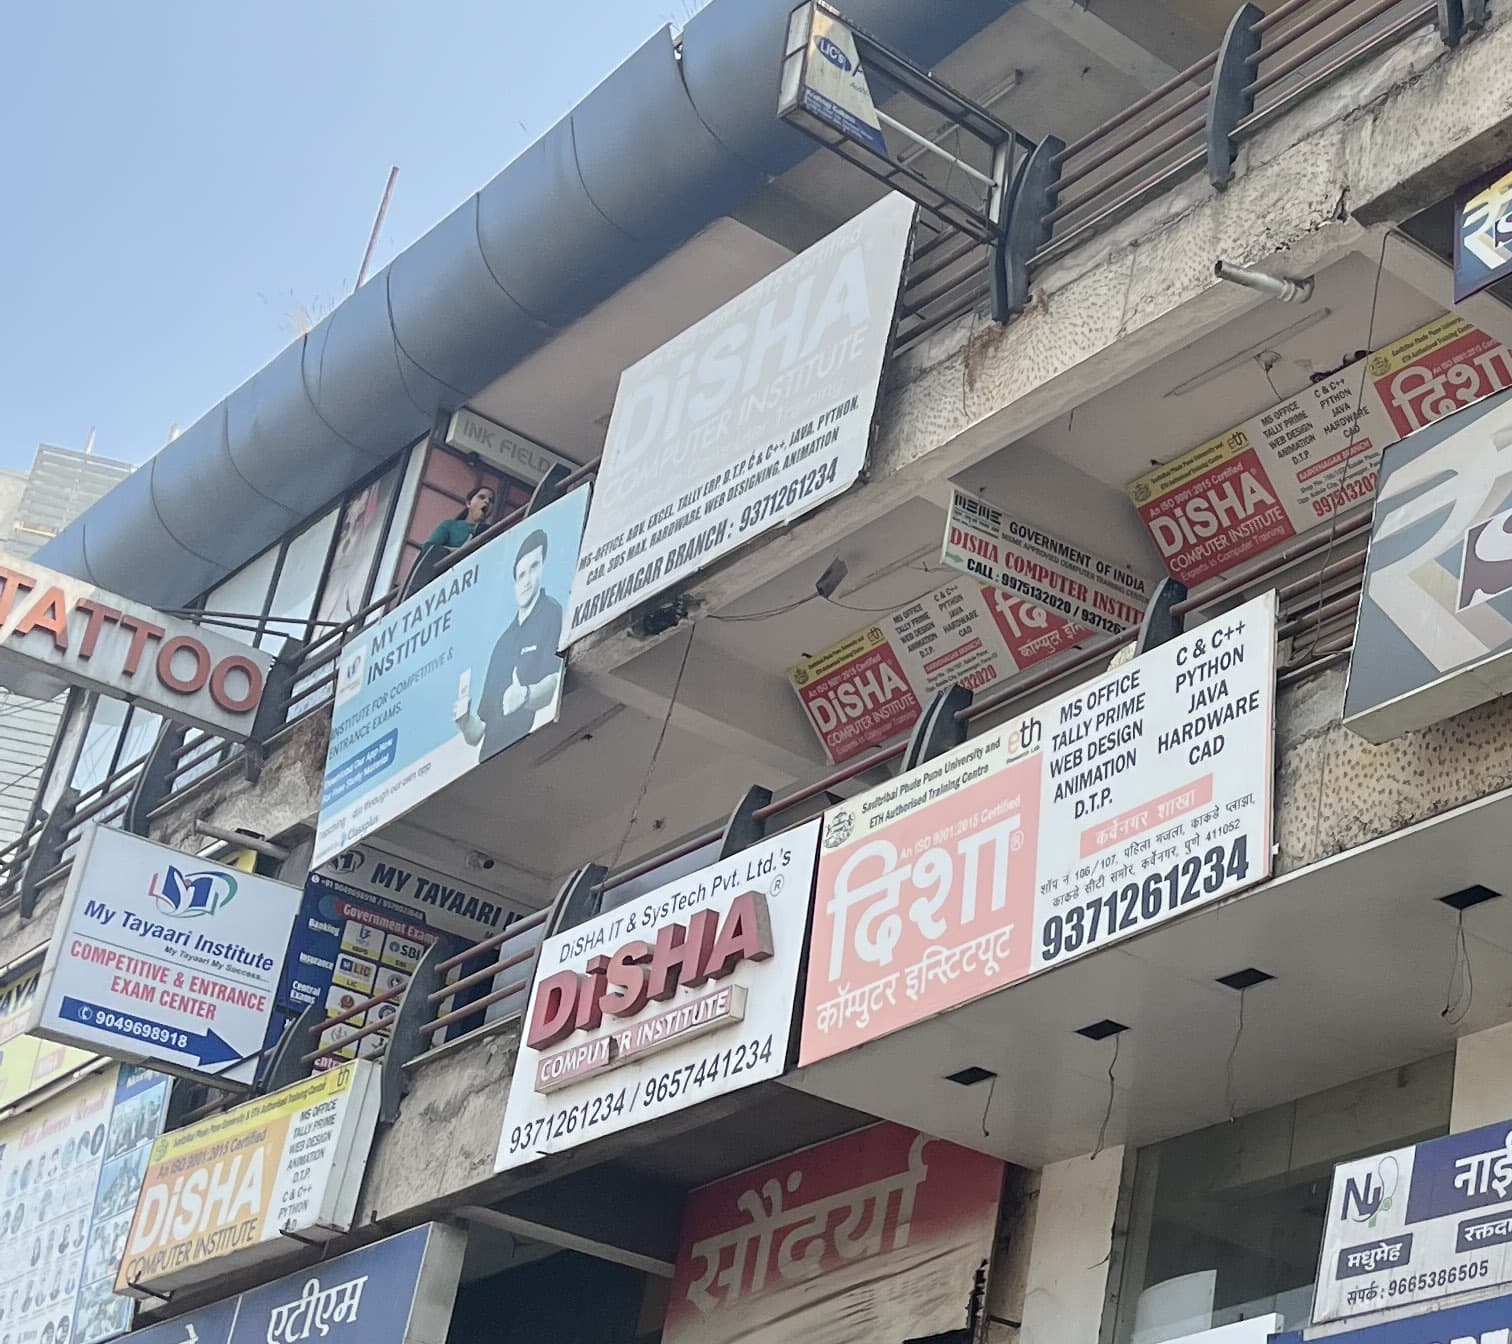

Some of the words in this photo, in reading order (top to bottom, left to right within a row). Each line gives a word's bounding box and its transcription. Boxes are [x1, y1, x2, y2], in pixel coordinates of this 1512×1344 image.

[617, 245, 871, 470] DiSHA
[1320, 389, 1352, 409] PYTHON
[1332, 403, 1351, 417] JAVA
[463, 420, 496, 449] INK
[571, 557, 662, 630] KARVENAGAR
[739, 456, 840, 532] 9371261234
[1149, 471, 1275, 557] DiSHA
[1169, 534, 1228, 572] COMPUTER
[1228, 506, 1284, 543] INSTITUTE
[950, 526, 999, 565] DISHA
[1005, 551, 1088, 603] COMPUTER
[967, 558, 994, 581] CALL
[1002, 573, 1071, 614] 9975132020
[1010, 522, 1091, 569] GOVERNMENT
[1096, 559, 1110, 576] OF
[1114, 570, 1145, 593] INDIA
[370, 625, 396, 657] MY
[401, 564, 479, 626] TAYAARI
[367, 609, 453, 686] INSTITUTE
[1175, 644, 1245, 694] PYTHON
[1176, 645, 1188, 667] C
[1192, 638, 1206, 659] &
[1211, 620, 1247, 653] C++
[808, 662, 909, 734] DiSHA
[1051, 725, 1093, 754] TALLY
[1095, 692, 1146, 739] PRIME
[1060, 699, 1083, 725] MS
[1086, 669, 1142, 716] OFFICE
[1157, 689, 1261, 756] HARDWARE
[1187, 679, 1230, 715] JAVA
[1007, 716, 1042, 755] eth
[1050, 750, 1084, 779] WEB
[1086, 718, 1144, 766] DESIGN
[1188, 734, 1226, 767] CAD
[1053, 747, 1137, 804] ANIMATION
[1074, 787, 1113, 820] D.T.P.
[343, 903, 407, 938] Government
[370, 863, 412, 893] MY
[413, 878, 503, 928] TAYAARI
[559, 932, 605, 964] DiSHA
[608, 917, 624, 944] IT
[710, 871, 741, 899] Pvt.
[827, 814, 1020, 982] दिशा
[1042, 833, 1250, 962] 9371261234
[84, 899, 117, 926] My
[121, 910, 193, 947] Tayaari
[195, 934, 274, 972] Institute
[70, 940, 170, 986] COMPETITIVE
[173, 972, 185, 989] &
[189, 976, 267, 1013] ENTRANCE
[111, 976, 158, 1003] EXAM
[159, 991, 217, 1021] CENTER
[527, 890, 775, 1051] DiSHA
[95, 1011, 188, 1049] 9049698918
[636, 989, 731, 1052] INSTITUTE
[509, 1091, 625, 1155] 9371261234
[643, 1034, 774, 1110] 9657441234
[130, 1145, 267, 1255] DiSHA
[193, 1218, 258, 1263] INSTITUTE
[1347, 1242, 1403, 1270] मधुमेह
[1388, 1259, 1489, 1297] 9665386505
